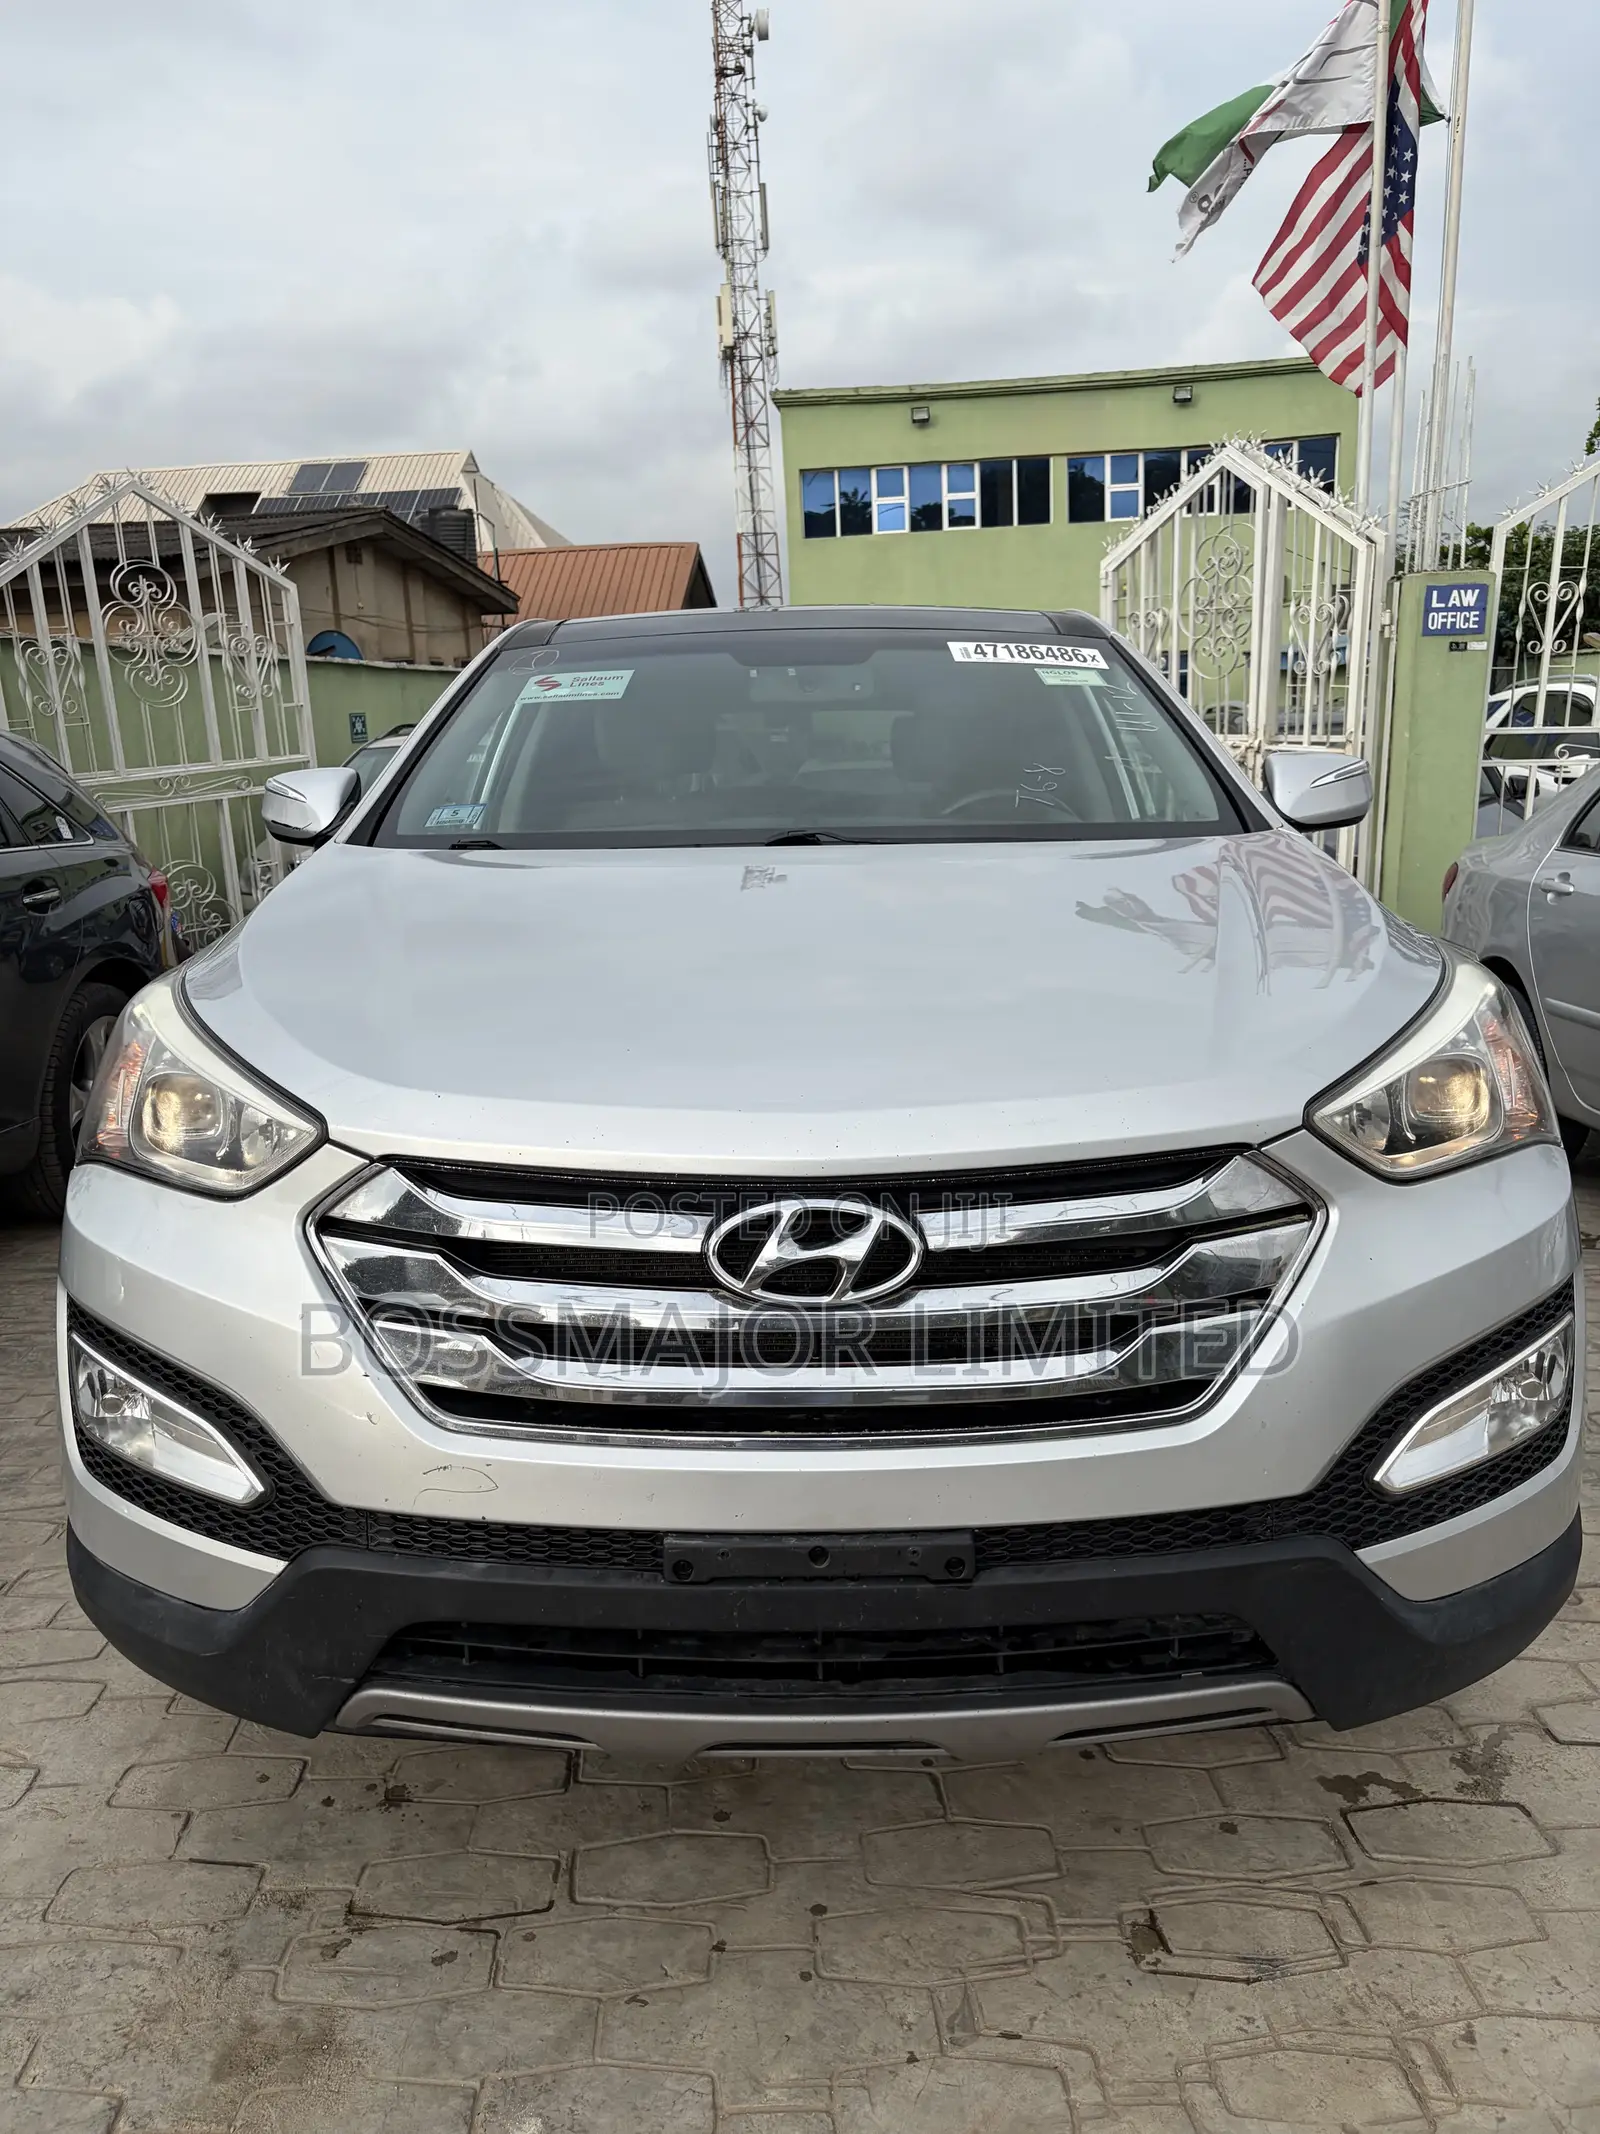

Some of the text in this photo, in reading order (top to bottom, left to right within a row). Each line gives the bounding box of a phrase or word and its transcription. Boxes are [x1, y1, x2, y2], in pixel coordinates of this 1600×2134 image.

[1431, 589, 1480, 608] LAW
[1428, 611, 1480, 630] OFFICE
[450, 809, 460, 817] 5
